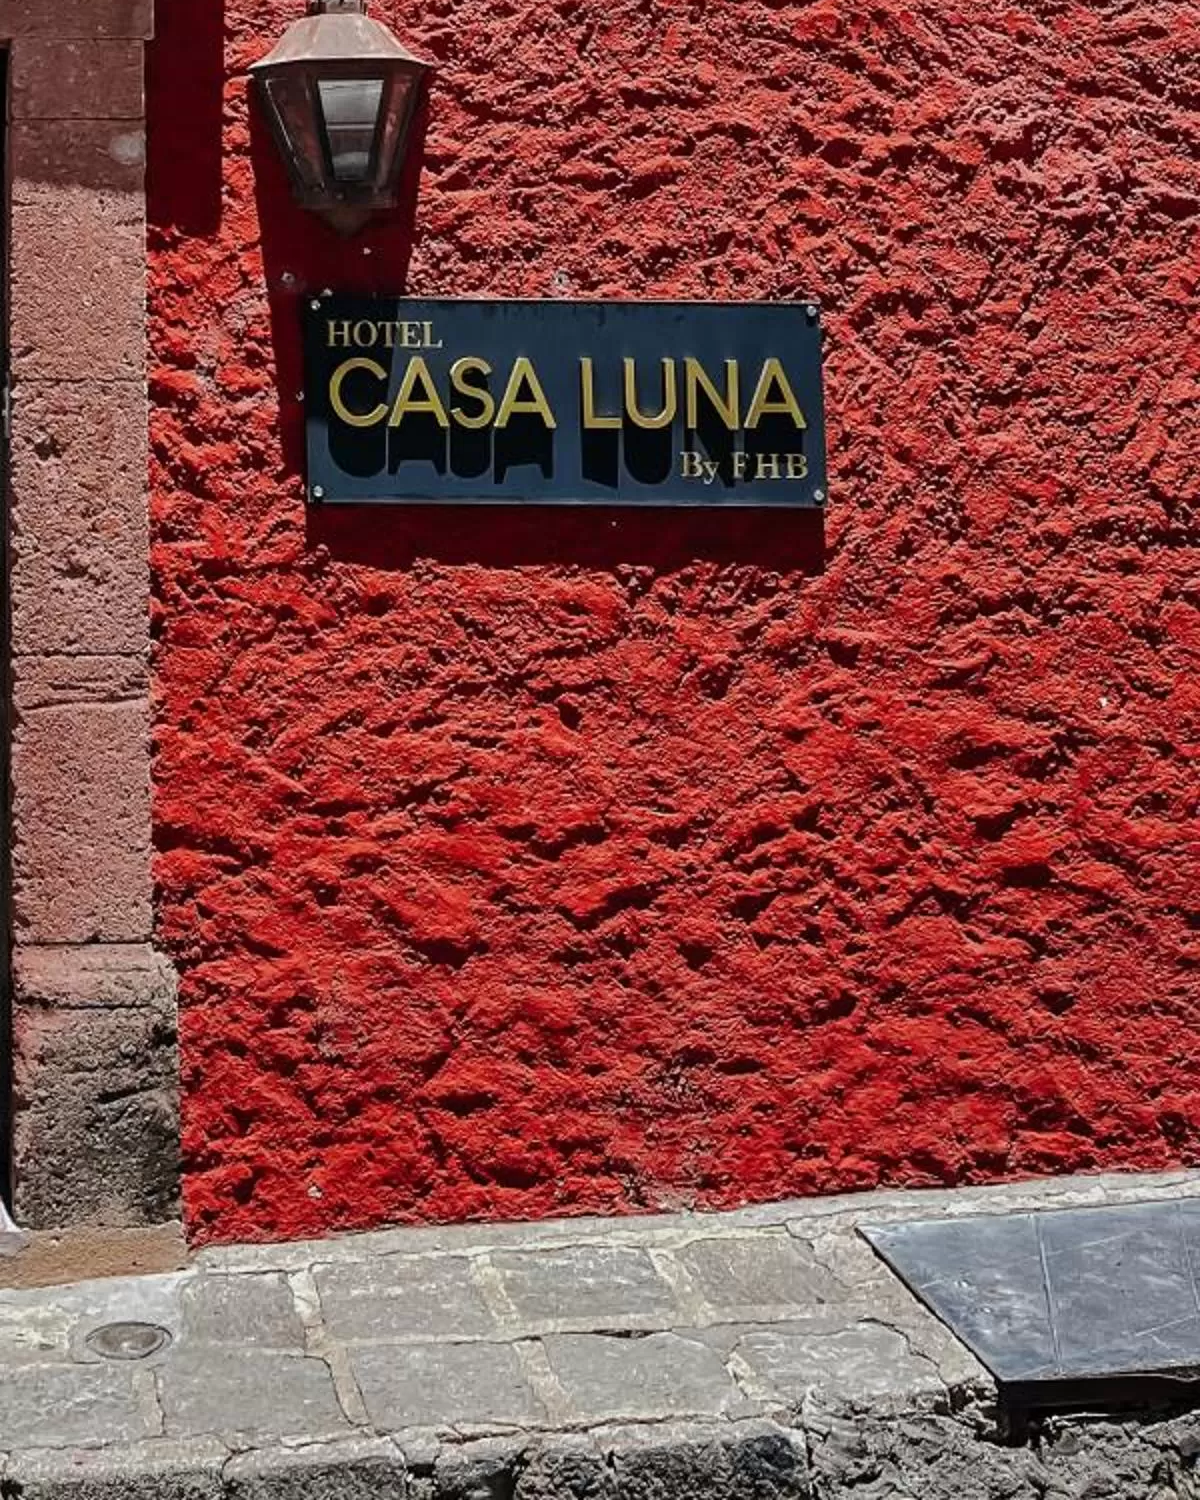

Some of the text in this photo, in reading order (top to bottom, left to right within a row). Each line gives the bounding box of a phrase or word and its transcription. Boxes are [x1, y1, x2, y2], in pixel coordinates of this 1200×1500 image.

[327, 320, 443, 349] HOTEL
[328, 357, 807, 430] CASA LUNA
[680, 451, 809, 485] By FHB
